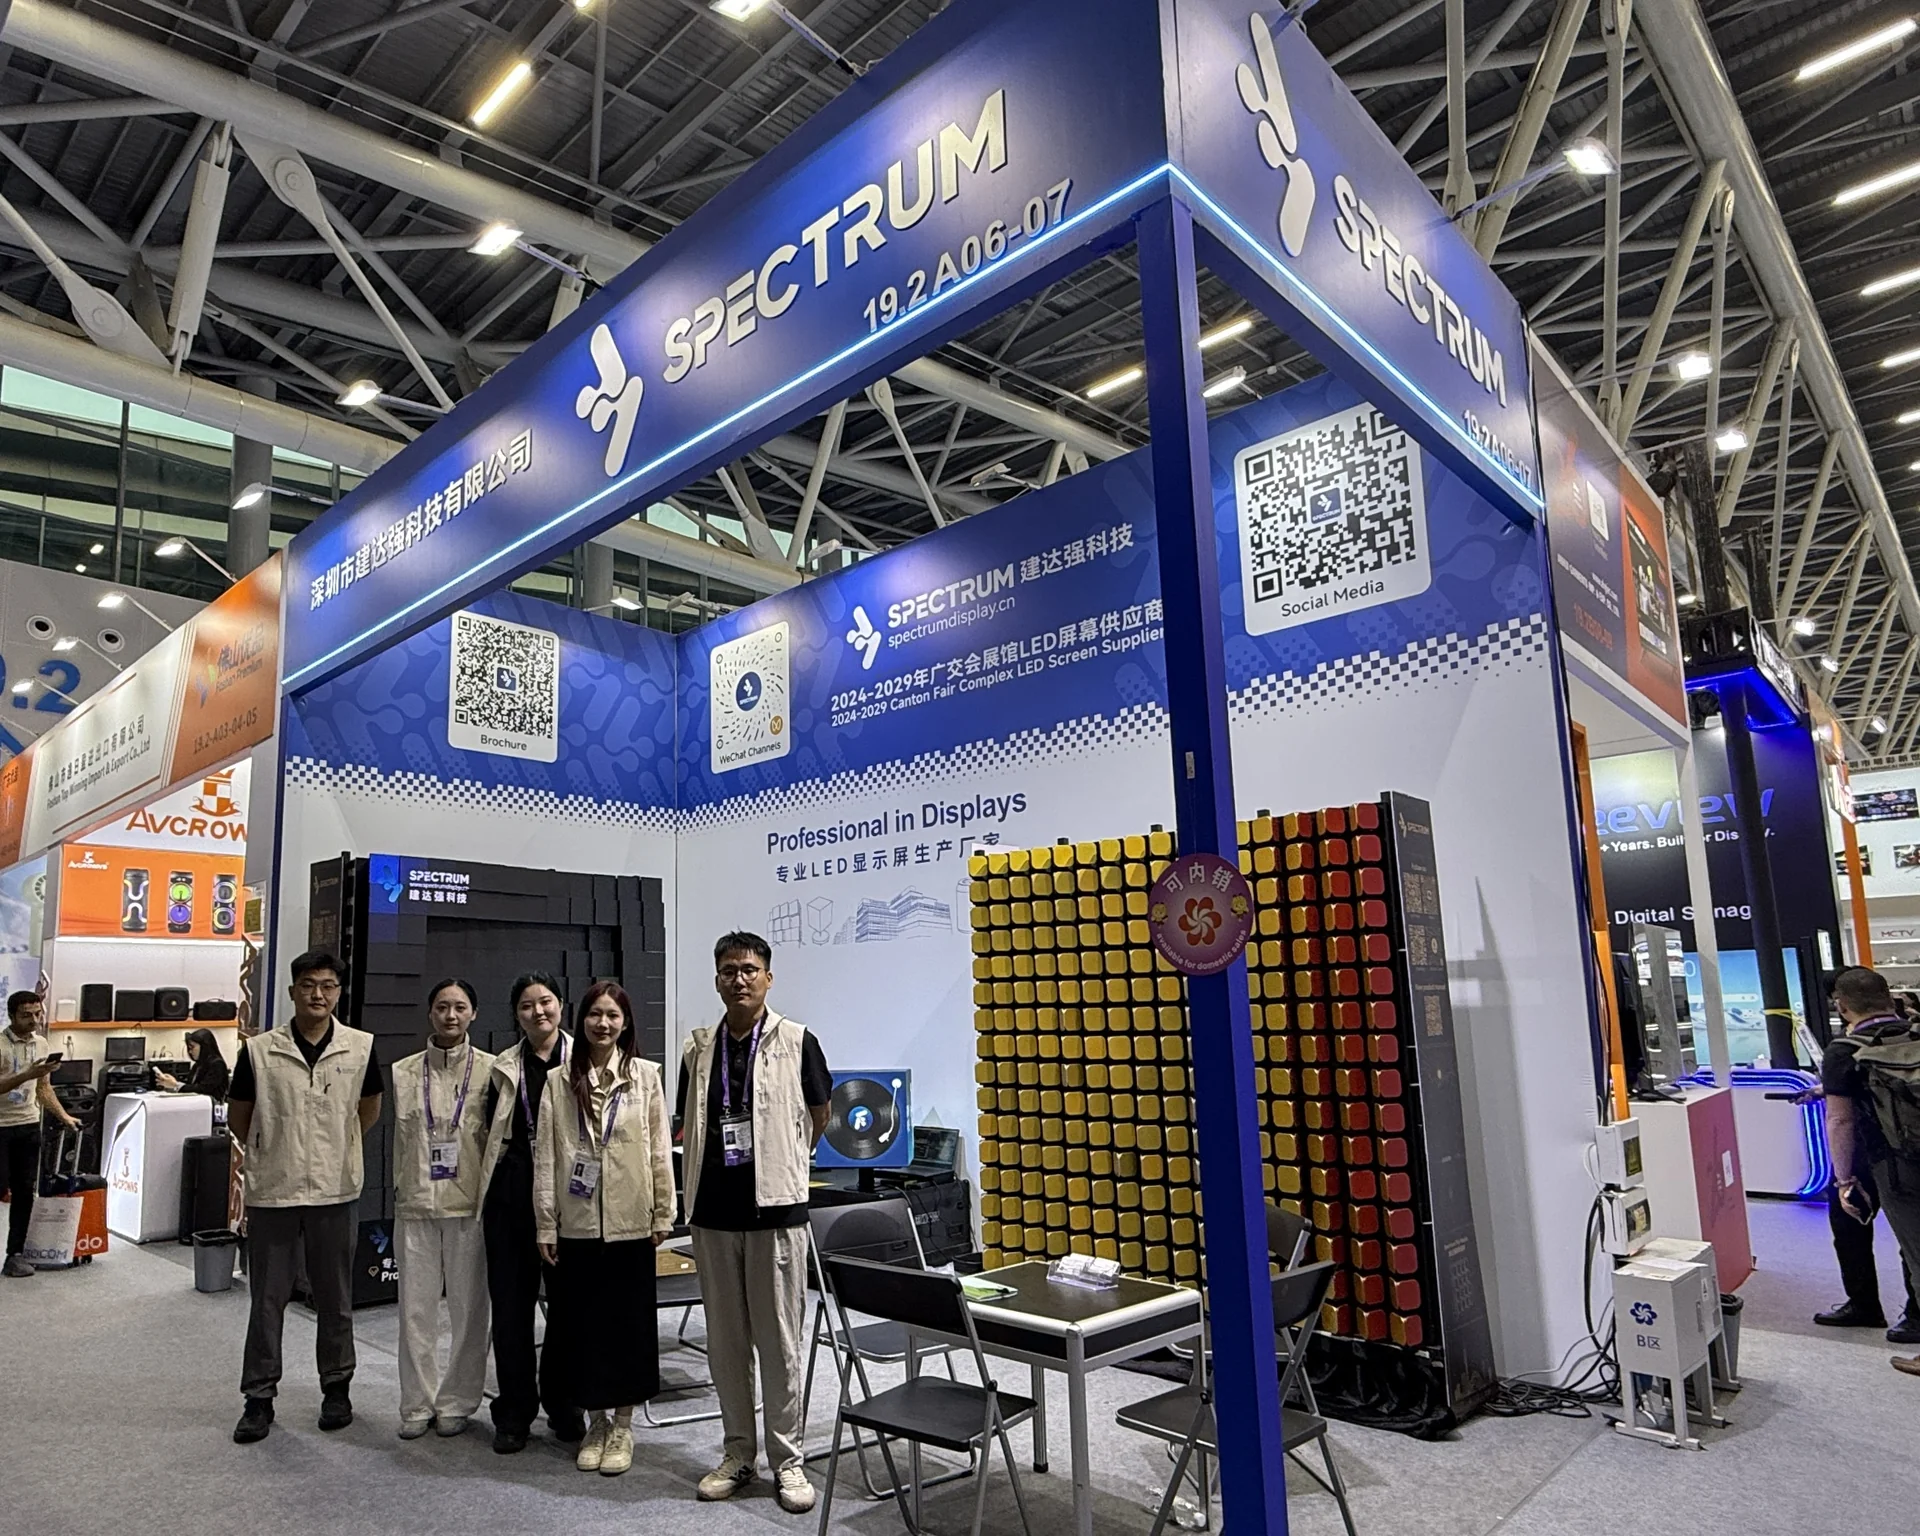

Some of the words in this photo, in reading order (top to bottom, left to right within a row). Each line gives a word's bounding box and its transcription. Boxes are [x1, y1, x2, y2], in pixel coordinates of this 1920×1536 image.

[662, 88, 1009, 384] SPECTRUM
[1332, 174, 1507, 408] SPECTRUM
[310, 428, 533, 612] 深圳市建达强科技有限公司
[888, 563, 1015, 629] SPECTRUM
[1020, 522, 1134, 585] 建达强科技
[1281, 593, 1329, 617] Social
[1333, 580, 1385, 604] Media
[888, 595, 1016, 649] spectrumdisplay.cn
[830, 598, 1164, 713] 2024-2029年广交会展馆LED屏幕供应商
[831, 702, 888, 728] 2024-2029
[890, 691, 931, 712] Canton
[933, 682, 955, 699] Fair
[959, 668, 1014, 693] Complex
[1017, 658, 1045, 677] LED
[1048, 645, 1098, 669] Screen
[480, 734, 528, 752] Brochure
[719, 750, 747, 765] WeChat
[748, 741, 781, 757] Channels
[126, 808, 248, 842] AVCROW
[767, 811, 889, 855] Professional
[895, 808, 915, 833] in
[922, 792, 1028, 828] Displays
[1610, 840, 1655, 853] Years.
[1657, 835, 1685, 848] Buil
[409, 869, 470, 884] SPECTRUM
[1162, 861, 1234, 893] 可内销
[409, 889, 467, 904] 建达强科技
[1614, 907, 1675, 924] Digital
[1681, 905, 1751, 920] Snag
[1156, 933, 1184, 965] available
[1184, 958, 1197, 969] for
[1197, 952, 1233, 970] domestic
[1231, 929, 1247, 953] sales
[1637, 1334, 1661, 1349] B区
